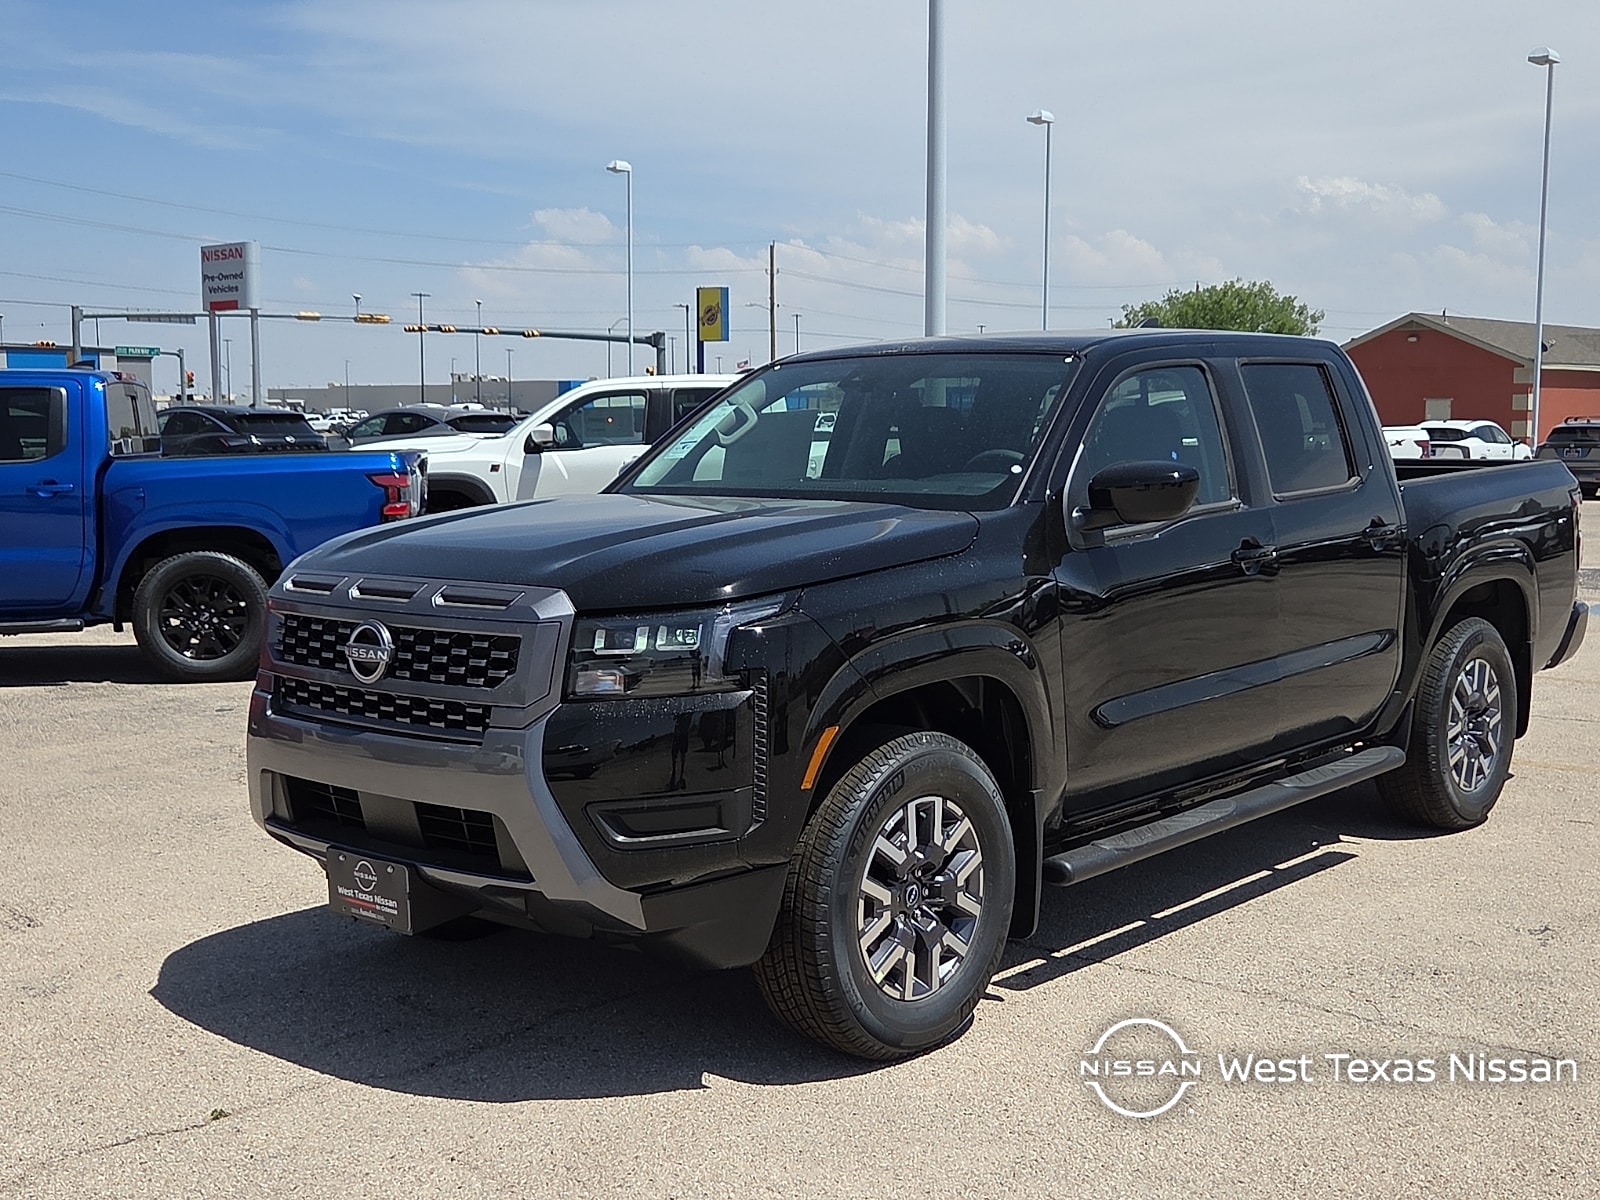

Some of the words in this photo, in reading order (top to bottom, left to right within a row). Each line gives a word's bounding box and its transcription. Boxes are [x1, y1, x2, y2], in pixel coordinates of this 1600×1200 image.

[202, 246, 243, 262] NISSAN
[203, 271, 243, 281] Pre-Owned
[208, 284, 239, 294] Vehicles
[852, 770, 905, 852] MICHELIN
[353, 871, 377, 881] NISSAN
[337, 885, 354, 898] West
[354, 889, 374, 902] Texas
[374, 894, 398, 908] Nissan
